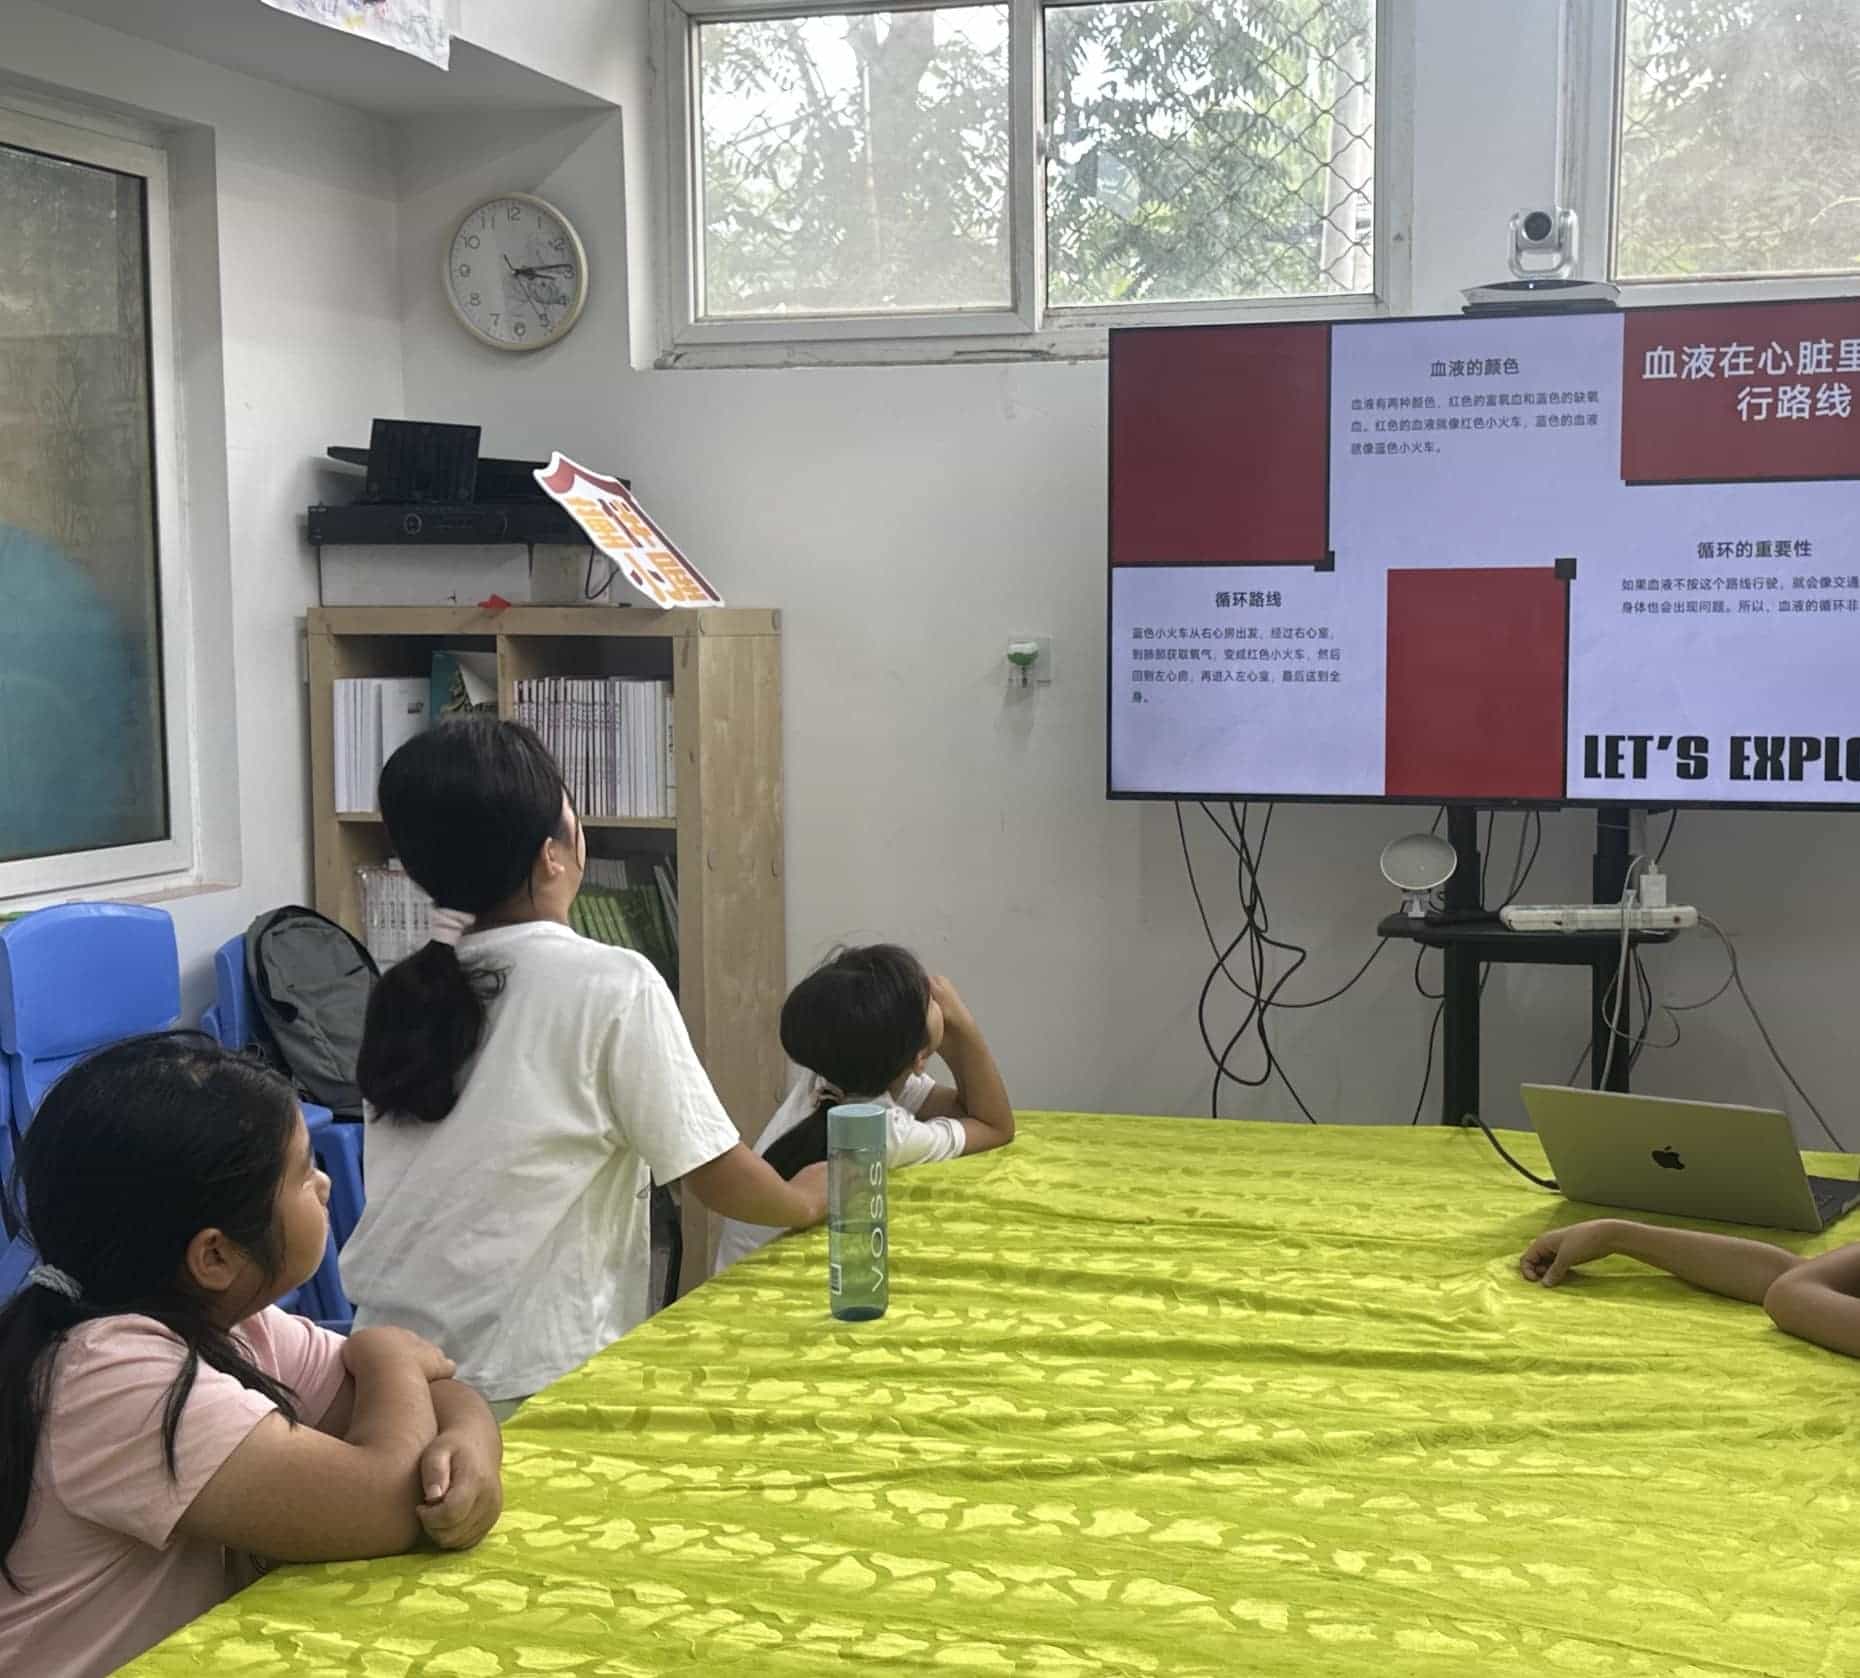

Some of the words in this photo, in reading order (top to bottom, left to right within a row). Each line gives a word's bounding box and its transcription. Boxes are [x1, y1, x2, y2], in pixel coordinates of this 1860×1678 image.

[507, 206, 521, 222] 12
[536, 215, 544, 230] 1
[481, 215, 496, 231] 11
[461, 235, 481, 250] 10
[469, 293, 481, 307] 8
[489, 312, 500, 328] 7
[1430, 357, 1520, 378] 血液的颜色
[1641, 338, 1860, 381] 血液在心脏里
[1736, 382, 1854, 422] 行路线
[1697, 540, 1812, 560] 循环的重要性
[1215, 591, 1282, 608] 循环路线
[1584, 736, 1709, 780] LET'S
[871, 1162, 884, 1292] VOSS
